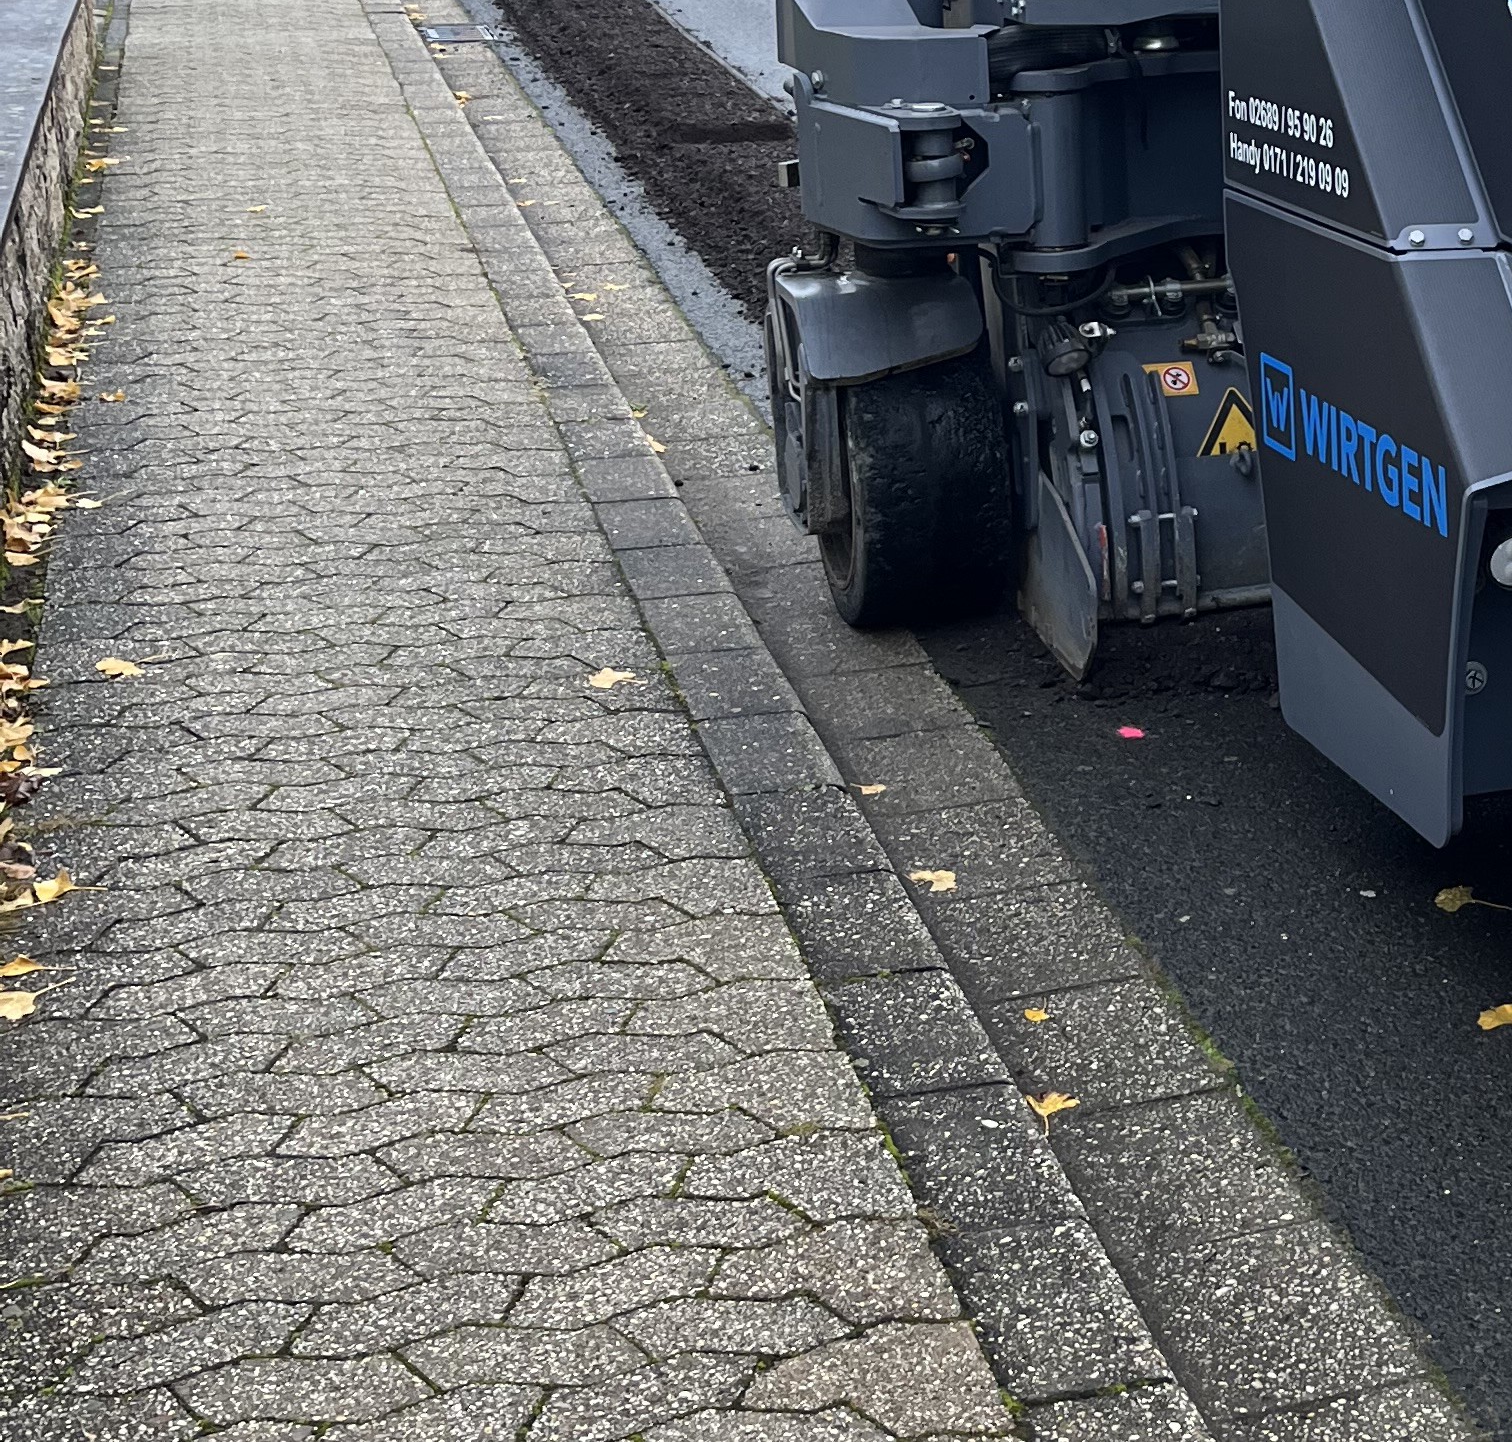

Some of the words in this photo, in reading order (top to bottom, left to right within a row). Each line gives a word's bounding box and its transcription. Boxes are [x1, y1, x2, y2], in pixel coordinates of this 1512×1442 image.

[1228, 90, 1248, 122] Fon
[1249, 96, 1279, 132] 02689
[1287, 107, 1301, 139] 95
[1303, 112, 1317, 143] 90
[1319, 117, 1334, 149] 26
[1229, 131, 1261, 175] Handy
[1262, 143, 1287, 177] 0171
[1296, 154, 1316, 187] 219
[1318, 161, 1332, 193] 09
[1334, 166, 1349, 198] 09
[1300, 388, 1448, 539] WIRTGEN
